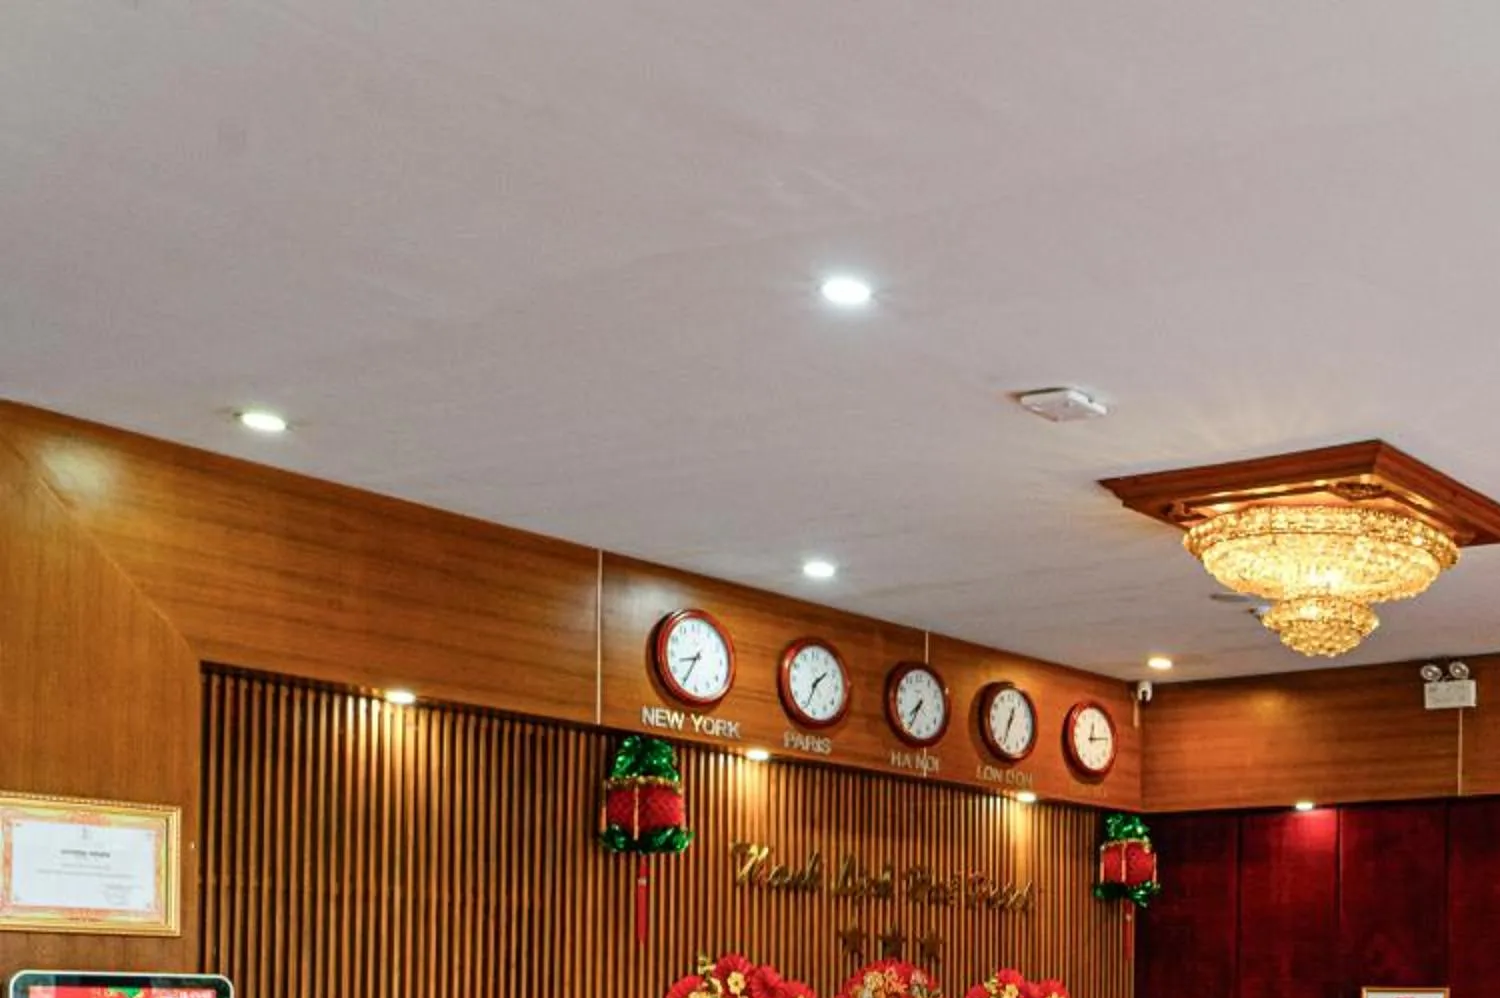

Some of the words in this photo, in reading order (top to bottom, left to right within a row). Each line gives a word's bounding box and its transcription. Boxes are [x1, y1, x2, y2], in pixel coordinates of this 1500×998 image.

[641, 706, 685, 731] NEW
[690, 713, 741, 740] YORK
[784, 732, 832, 755] PARIS
